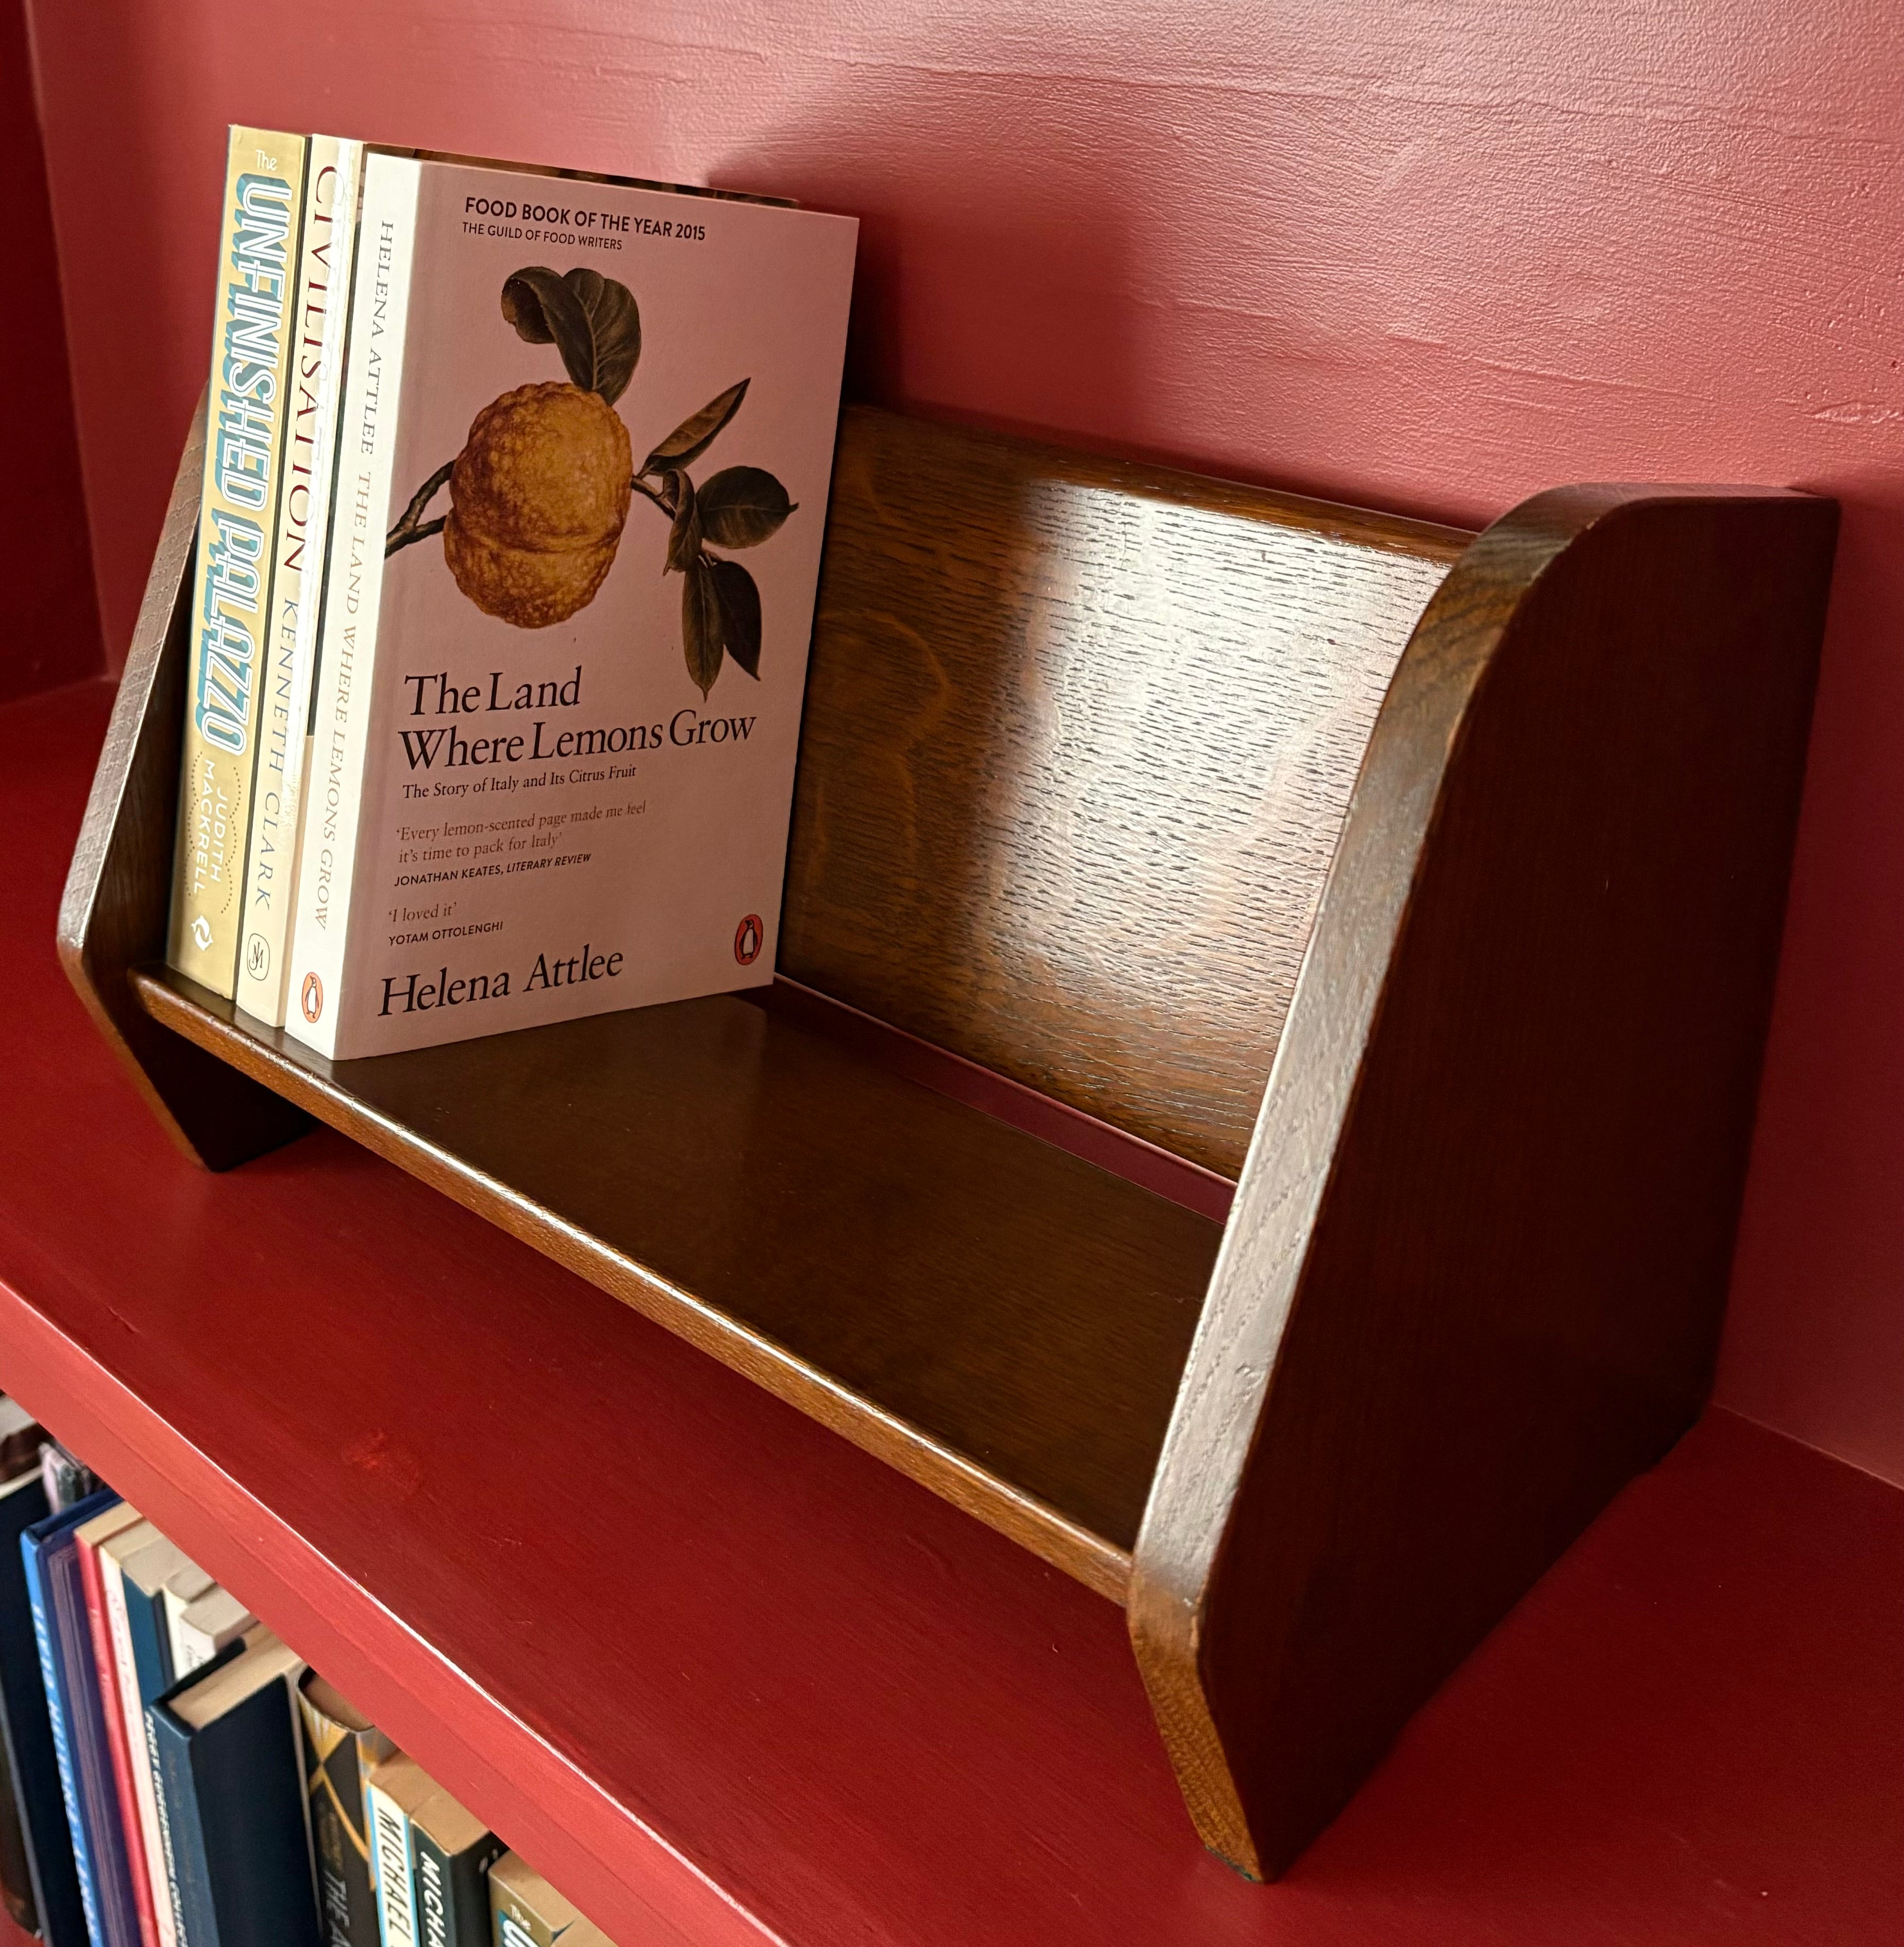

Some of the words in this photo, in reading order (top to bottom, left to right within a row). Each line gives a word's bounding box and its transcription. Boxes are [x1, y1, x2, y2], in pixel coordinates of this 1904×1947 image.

[255, 149, 277, 171] The
[462, 222, 484, 234] THE
[488, 225, 522, 239] GUILD
[525, 229, 541, 241] OF
[543, 231, 575, 244] FOOD
[578, 235, 622, 250] WRITERS
[465, 197, 517, 218] FOOD
[522, 204, 571, 225] BOOK
[574, 211, 597, 227] OF
[601, 214, 630, 232] THE
[634, 217, 672, 237] YEAR
[675, 223, 705, 241] 2015
[371, 220, 394, 338] HELENA
[215, 174, 292, 512] UNFINISHED
[284, 165, 345, 572] CIVILISATION
[361, 348, 382, 455] ATTLEE
[354, 472, 371, 528] THE
[347, 535, 364, 614] LAND
[196, 508, 265, 756] PALAZZO
[269, 597, 299, 774] KENNETH
[335, 625, 356, 724] WHERE
[404, 671, 481, 716] The
[485, 665, 582, 711] Land
[398, 725, 524, 770] Where
[528, 721, 663, 760] Lemons
[669, 709, 756, 746] Grow
[323, 729, 346, 842] LEMONS
[403, 784, 429, 798] The
[434, 782, 469, 797] Story
[473, 777, 488, 793] of
[490, 776, 519, 793] Italy
[523, 772, 547, 788] and
[549, 771, 565, 786] Its
[569, 769, 605, 784] Citrus
[609, 764, 637, 779] Fruit
[444, 813, 536, 837] lemon-scented
[538, 813, 567, 830] page
[571, 806, 602, 822] made
[606, 806, 623, 818] me
[626, 800, 647, 814] feel
[194, 759, 215, 894] MACKRELL
[210, 787, 228, 882] JUDITH
[256, 792, 279, 910] CLARK
[423, 847, 452, 861] time
[456, 846, 470, 857] to
[473, 838, 504, 858] pack
[508, 837, 527, 851] for
[316, 849, 333, 931] GROW
[394, 870, 458, 887] JONATHAN
[462, 864, 504, 879] KEATES,
[506, 858, 553, 873] LITERARY
[555, 853, 591, 867] REVIEW
[388, 931, 429, 946] YOTAM
[432, 921, 503, 940] OTTOLENGHI
[403, 904, 438, 922] loved
[377, 966, 511, 1017] Helena
[523, 943, 624, 992] Attlee
[324, 1869, 350, 1928] THE
[377, 1807, 412, 1940] MICHAEL
